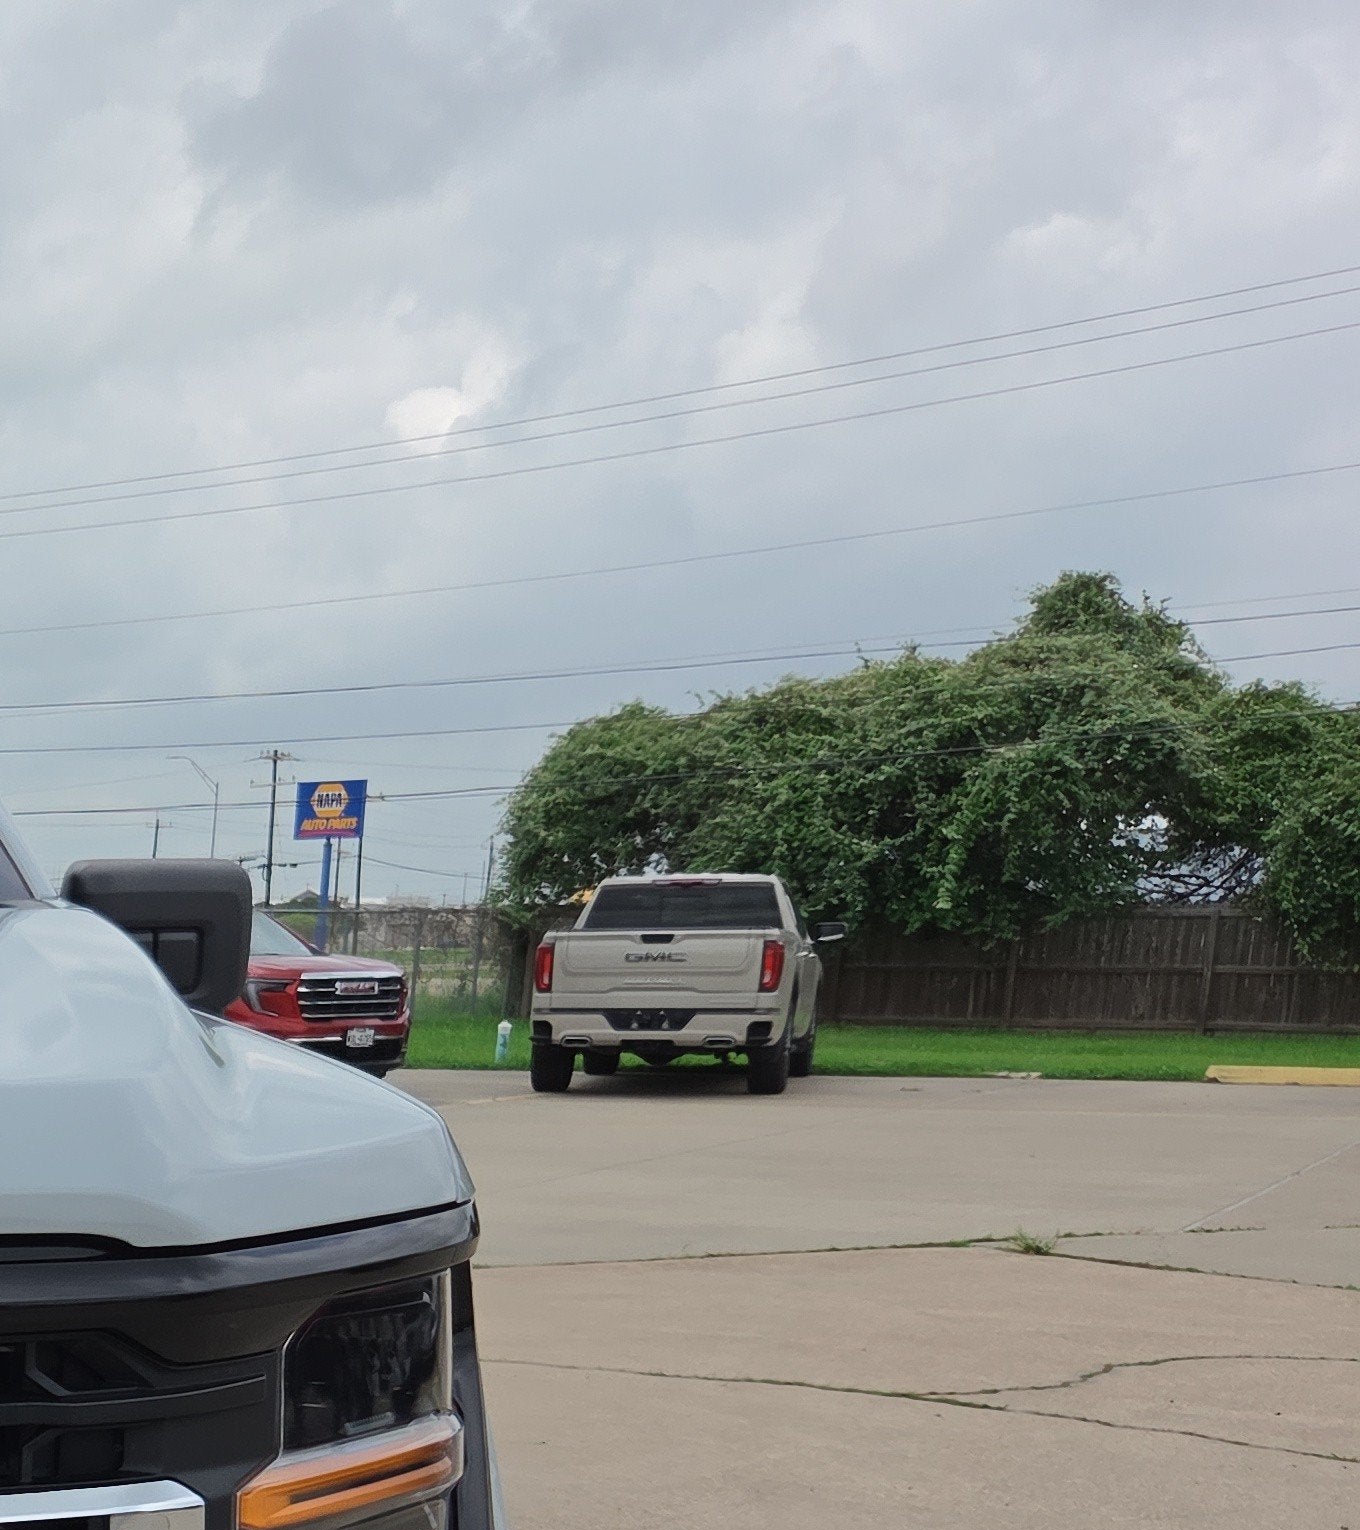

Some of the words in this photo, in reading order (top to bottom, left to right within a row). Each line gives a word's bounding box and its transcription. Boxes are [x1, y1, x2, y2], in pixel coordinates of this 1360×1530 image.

[316, 792, 343, 808] NAPA
[300, 818, 327, 831] AUTO
[327, 817, 359, 830] PARTS
[625, 952, 687, 962] GMC
